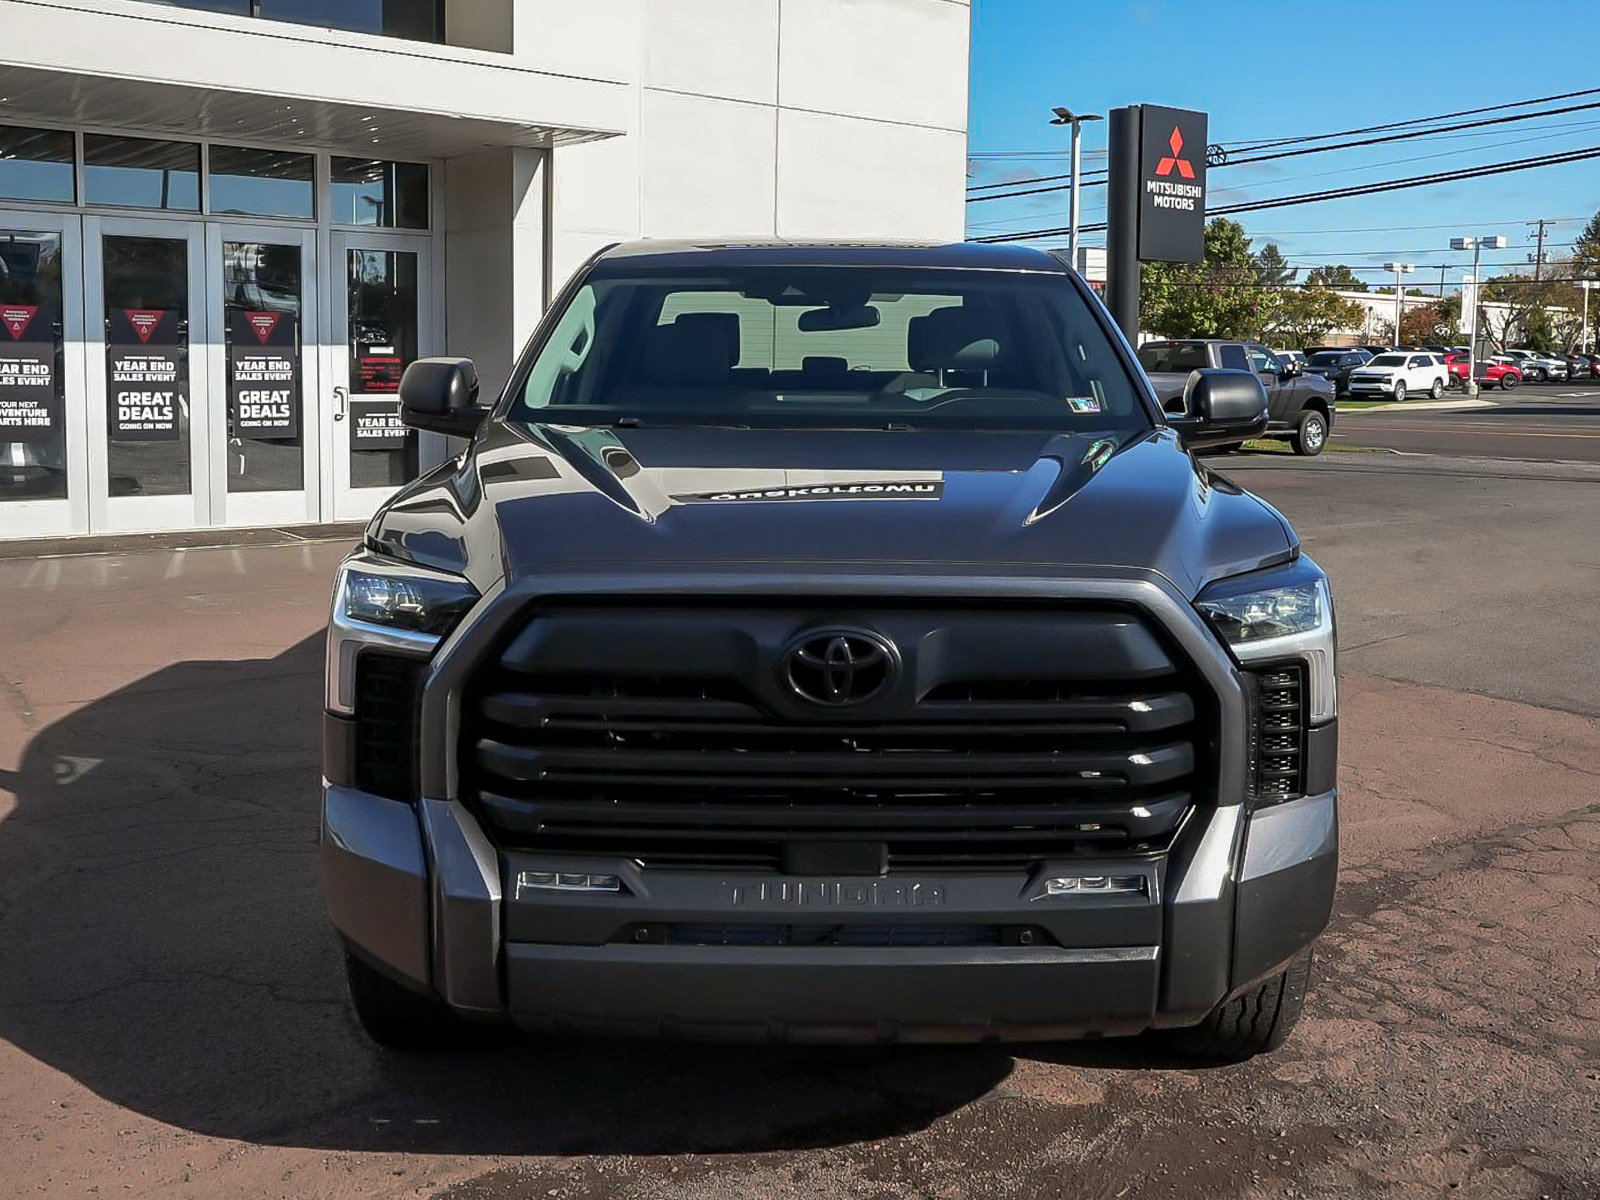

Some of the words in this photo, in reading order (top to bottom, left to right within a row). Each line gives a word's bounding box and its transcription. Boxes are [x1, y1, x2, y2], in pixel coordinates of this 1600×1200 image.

[1147, 181, 1202, 198] MITSUBISHI
[1154, 195, 1194, 210] MOTORS
[22, 364, 49, 375] END
[115, 361, 147, 371] YEAR
[150, 361, 174, 371] END
[236, 361, 266, 370] YEAR
[268, 361, 291, 371] END
[17, 377, 51, 386] EVENT
[114, 373, 143, 382] SALES
[145, 373, 176, 382] EVENT
[235, 373, 262, 381] SALES
[264, 373, 292, 381] EVENT
[118, 392, 173, 406] GREAT
[239, 390, 290, 404] GREAT
[118, 406, 173, 421] DEALS
[240, 404, 290, 419] DEALS
[23, 417, 51, 426] HERE
[119, 422, 142, 430] GOING
[142, 422, 154, 430] ON
[155, 422, 173, 430] NOW
[358, 418, 386, 427] YEAR
[356, 429, 383, 438] SALES
[384, 429, 411, 438] EVENT
[721, 881, 946, 907] TUNDRA
